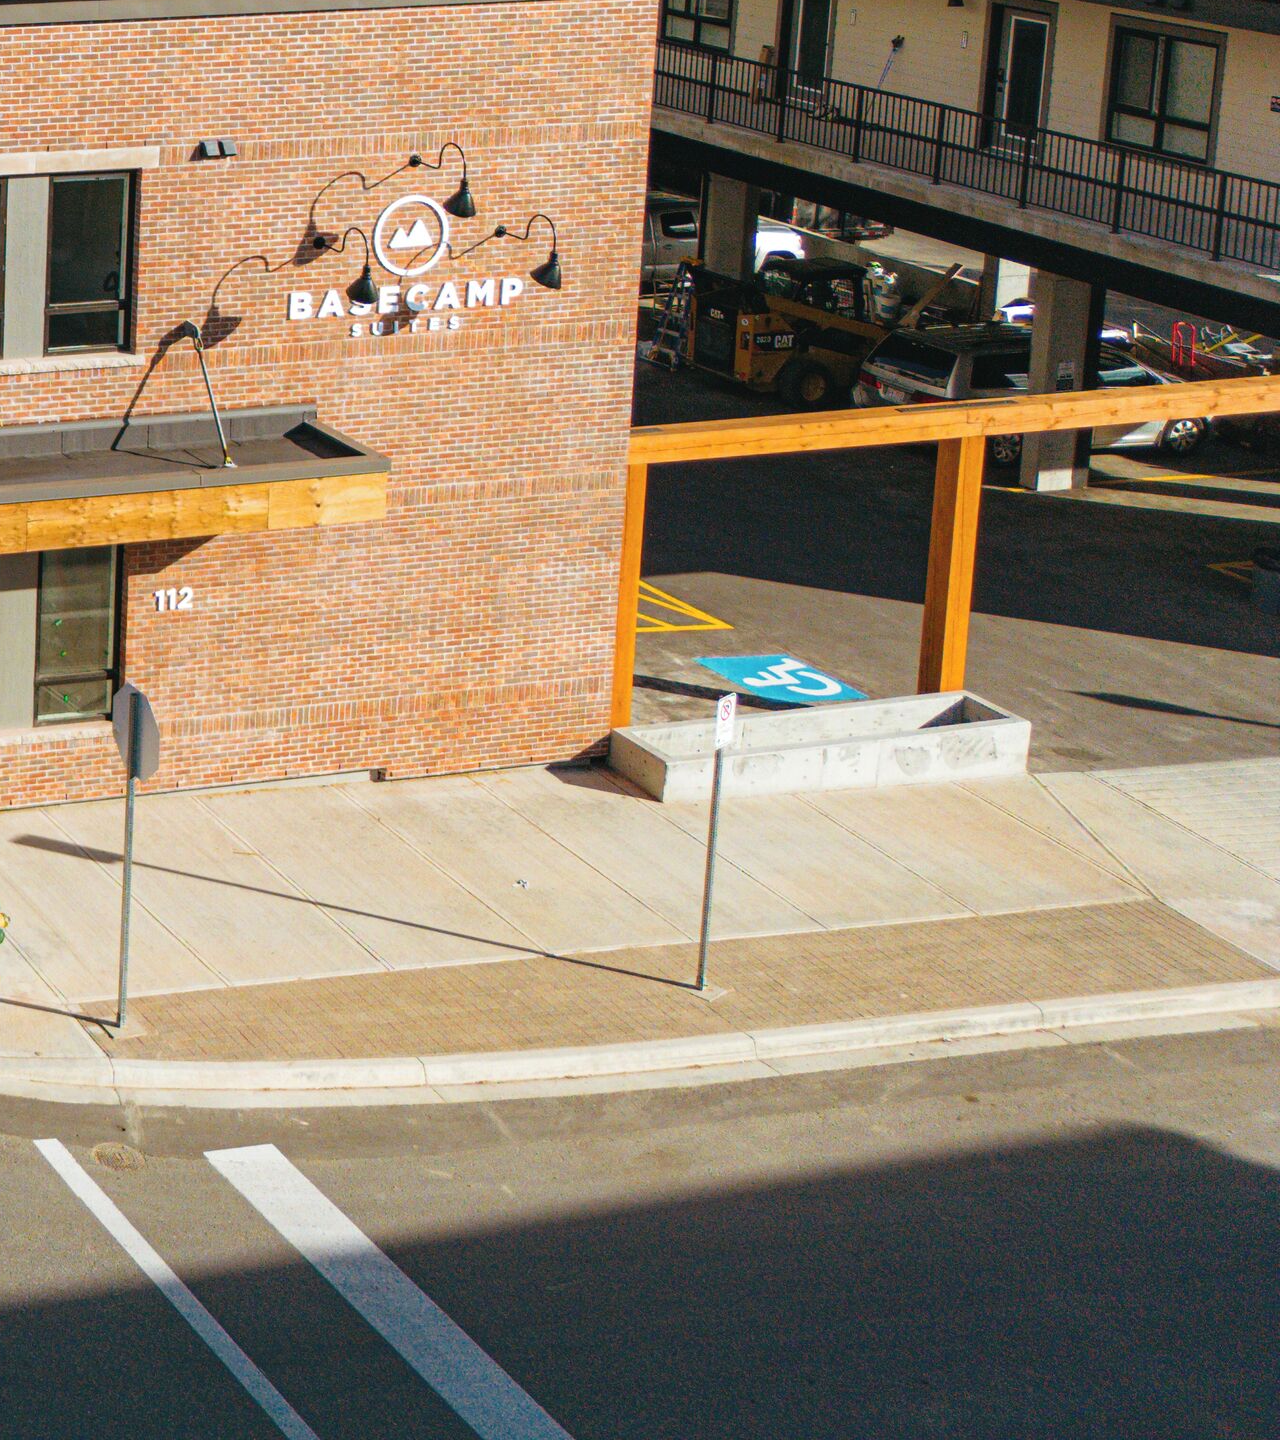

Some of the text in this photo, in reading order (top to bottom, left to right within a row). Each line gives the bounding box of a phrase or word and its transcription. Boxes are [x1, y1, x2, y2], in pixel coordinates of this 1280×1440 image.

[710, 308, 722, 319] CAT
[350, 316, 460, 338] SUITES
[774, 334, 794, 348] CAT
[153, 586, 193, 613] 112
